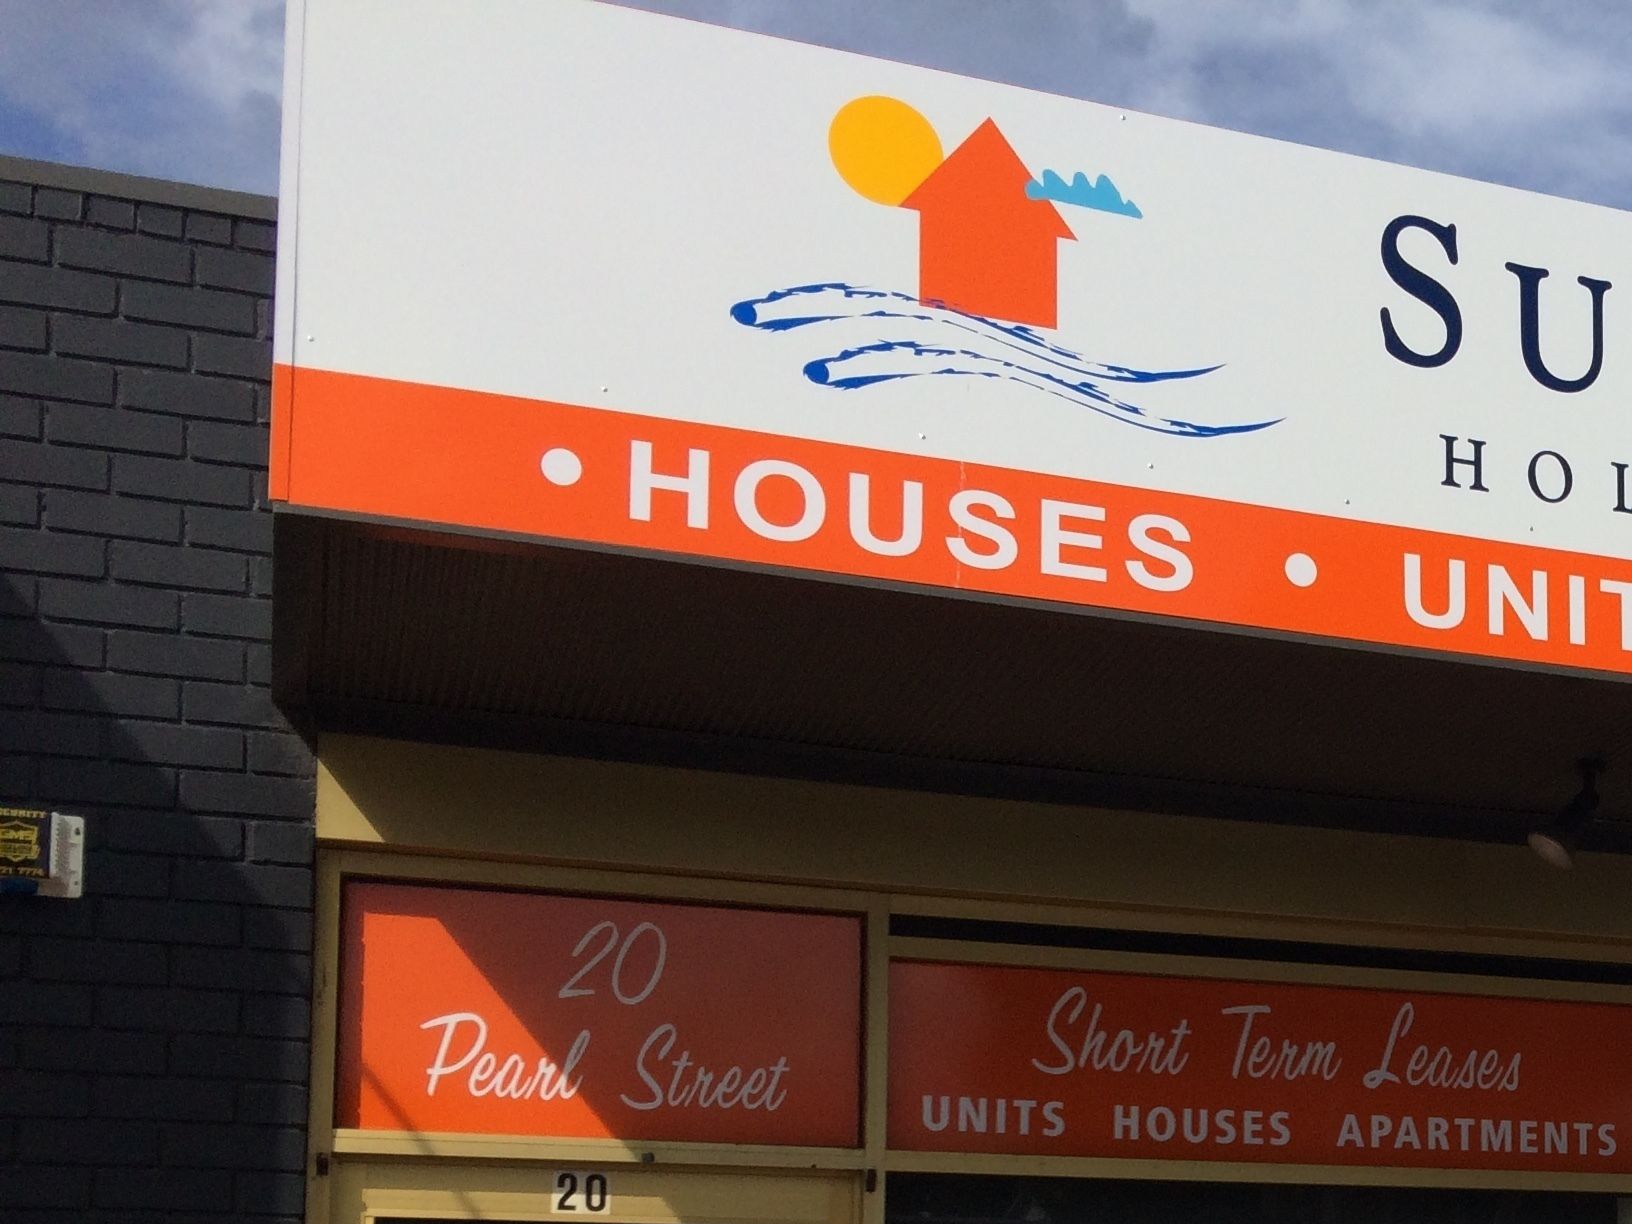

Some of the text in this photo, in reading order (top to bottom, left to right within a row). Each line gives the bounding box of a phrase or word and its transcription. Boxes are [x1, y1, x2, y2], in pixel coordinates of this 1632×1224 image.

[628, 441, 1195, 593] HOUSES
[558, 922, 667, 1005] 20
[420, 1012, 790, 1111] Pearl Street
[1032, 986, 1523, 1092] Short Term Leases
[922, 1095, 1616, 1157] UNITS HOUSES APARTMENTS
[556, 1172, 608, 1212] 20
